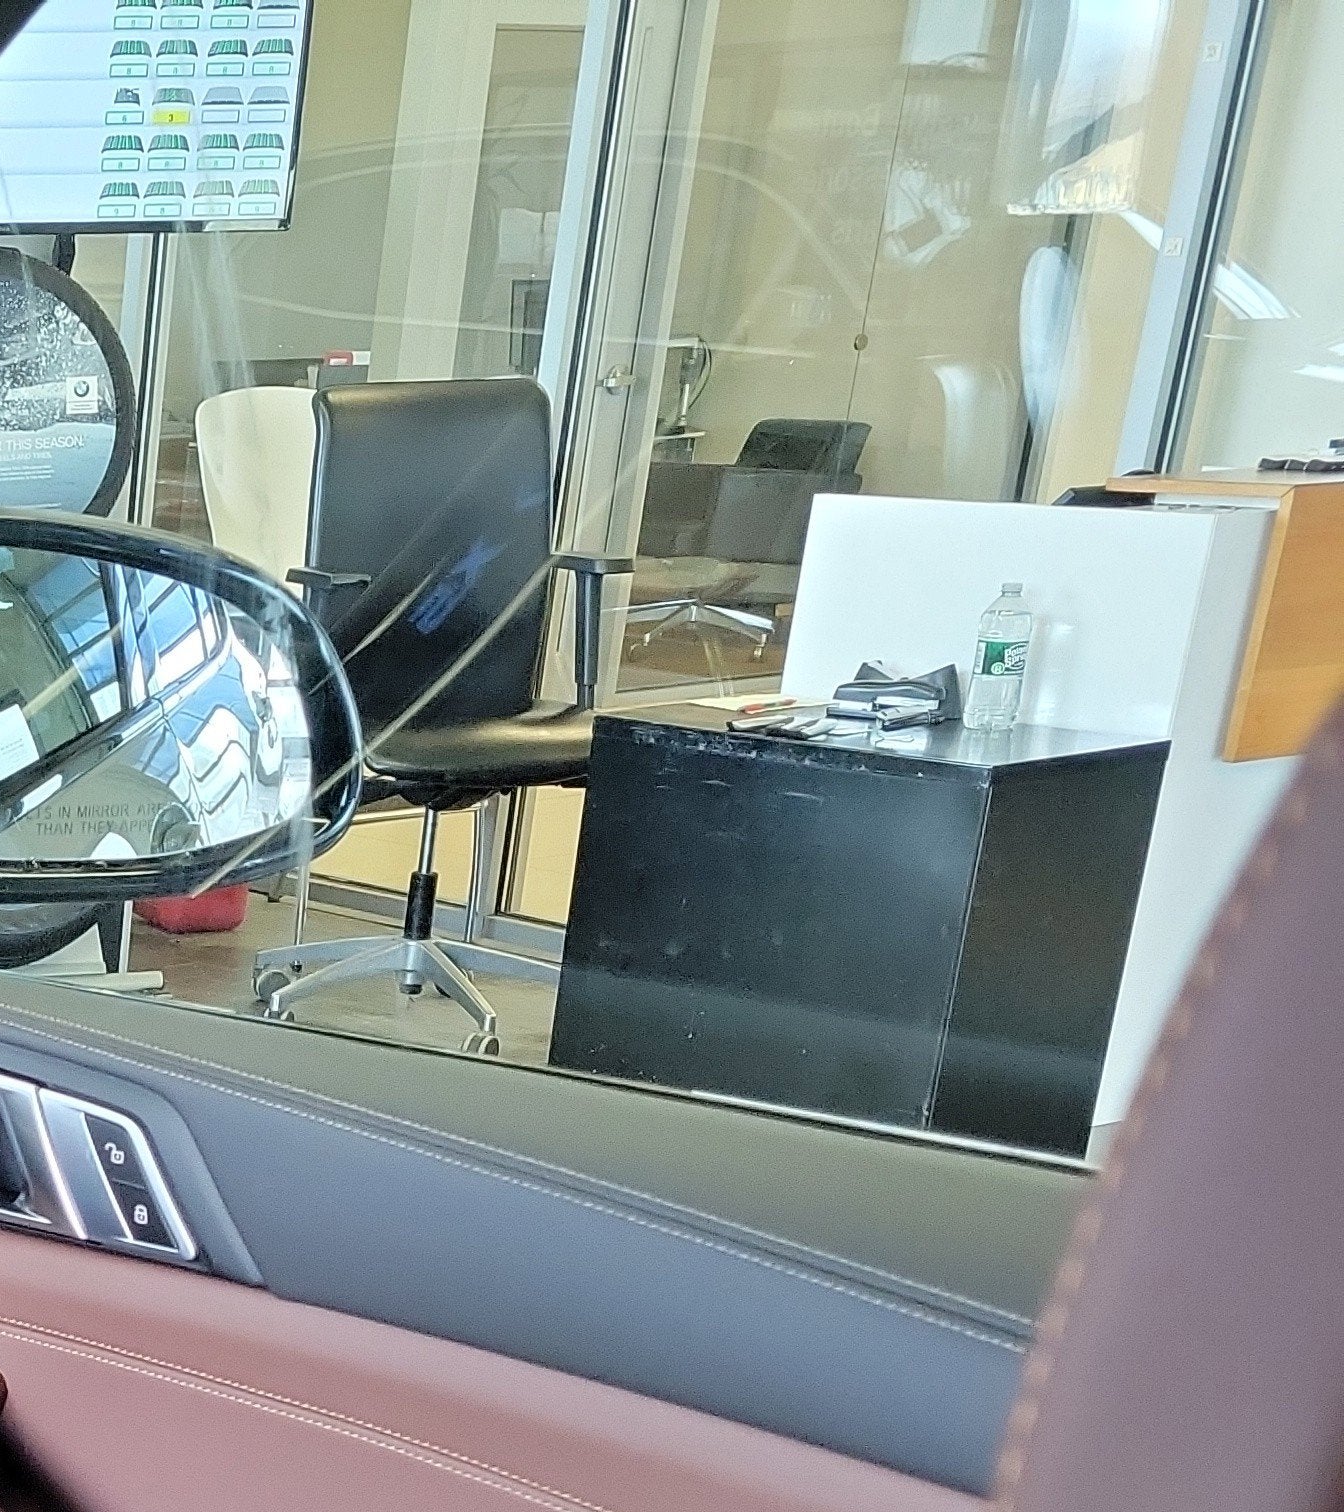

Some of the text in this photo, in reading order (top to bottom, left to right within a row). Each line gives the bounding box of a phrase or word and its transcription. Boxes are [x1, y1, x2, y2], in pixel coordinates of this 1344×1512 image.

[6, 438, 33, 451] THIS
[35, 434, 85, 449] SEASON.
[58, 805, 72, 819] IN
[77, 803, 130, 819] MIRROR
[36, 821, 73, 837] THAN
[81, 819, 112, 835] THEY
